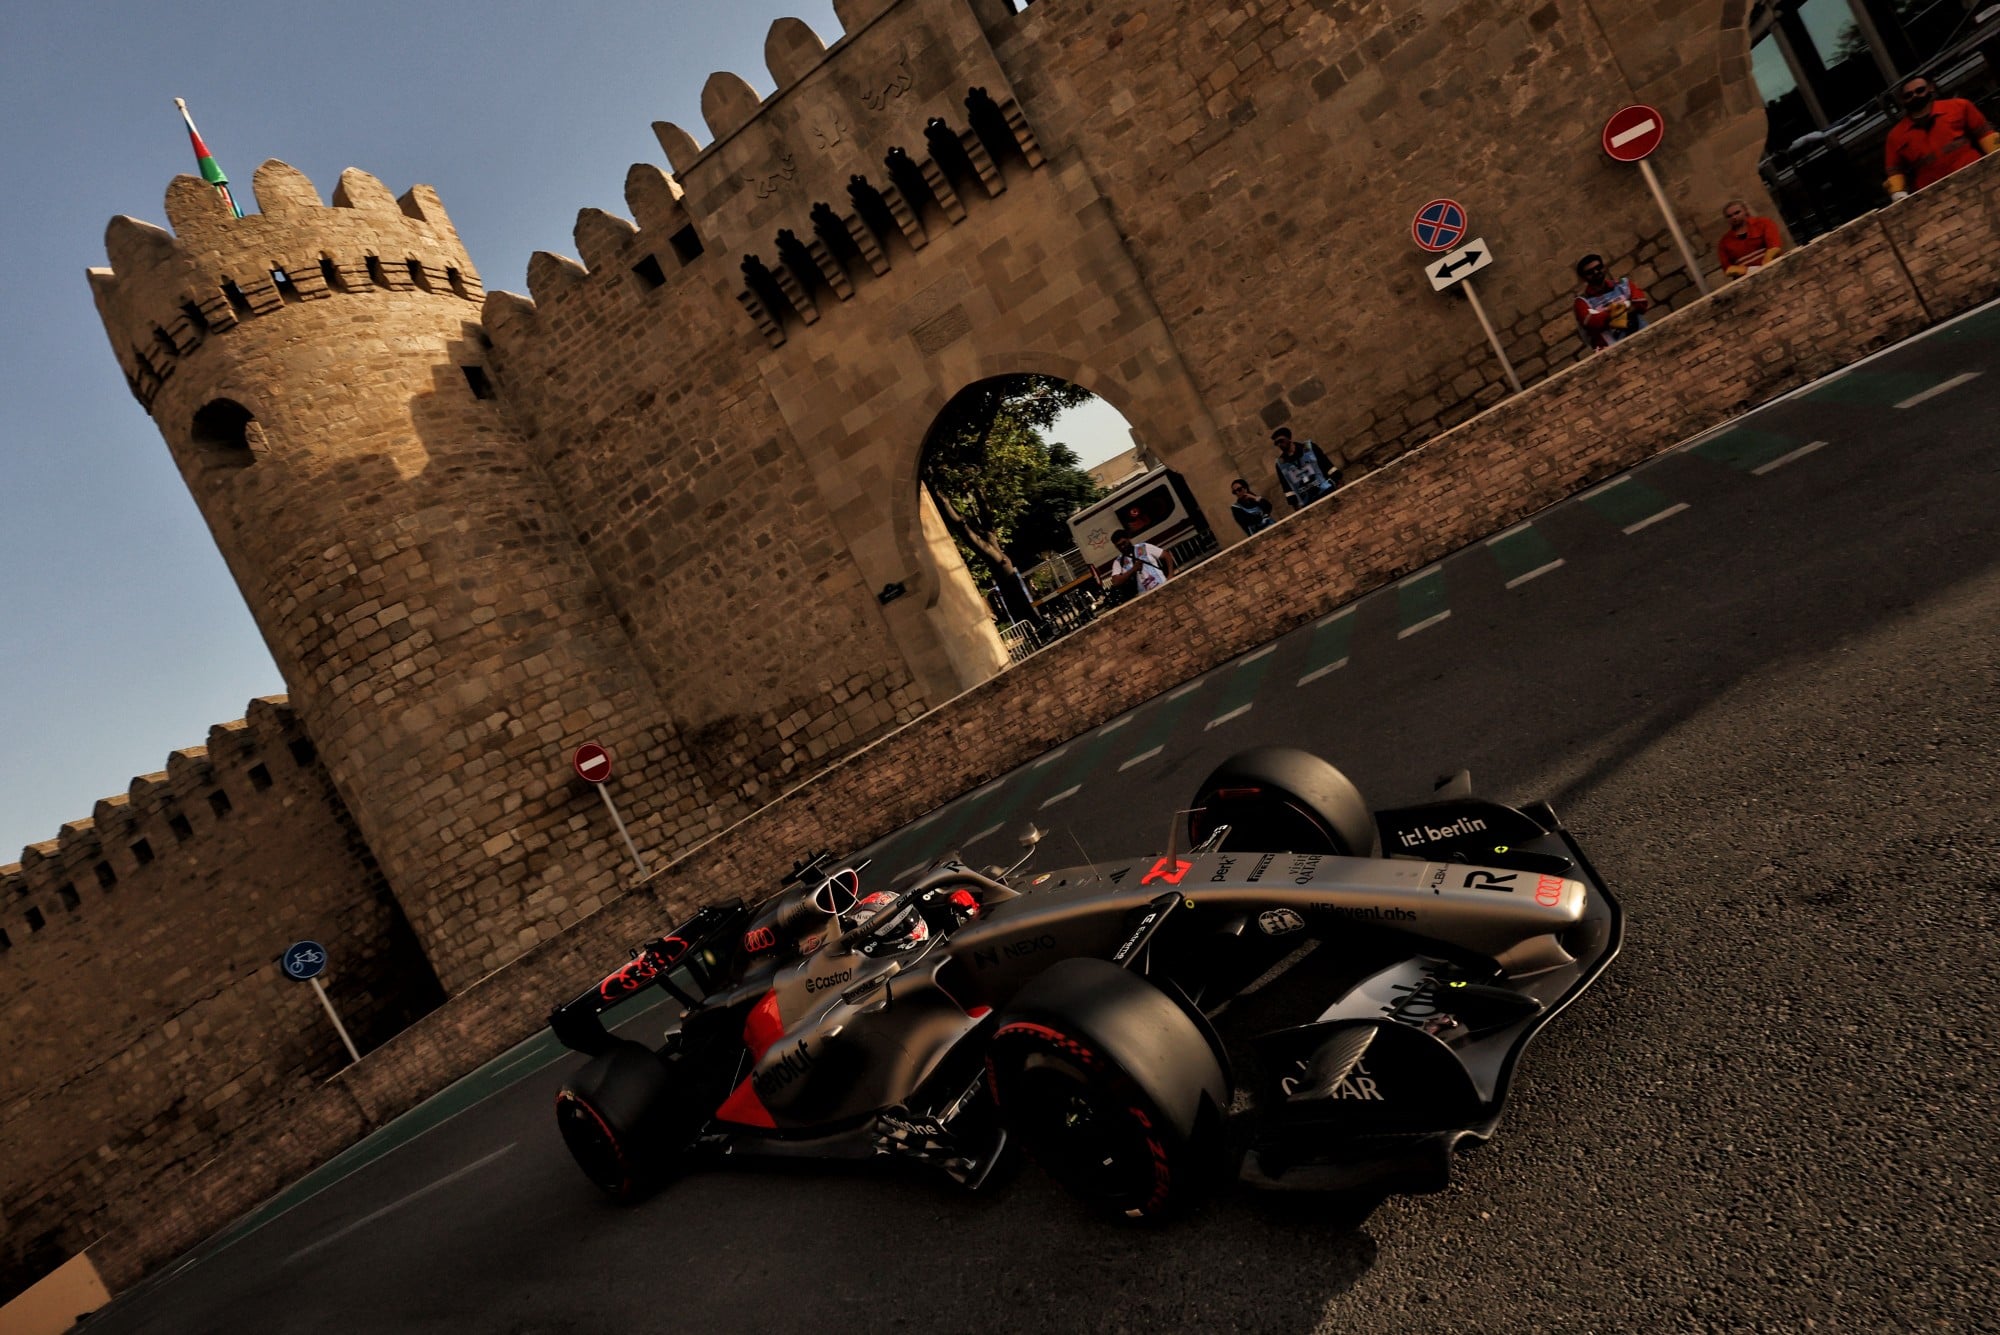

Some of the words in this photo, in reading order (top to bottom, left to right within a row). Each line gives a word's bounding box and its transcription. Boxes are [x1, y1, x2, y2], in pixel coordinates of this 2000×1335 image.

[1397, 827, 1425, 848] ic!
[1426, 816, 1488, 842] berlin
[1004, 934, 1056, 958] NEXO
[815, 967, 852, 991] Castrol
